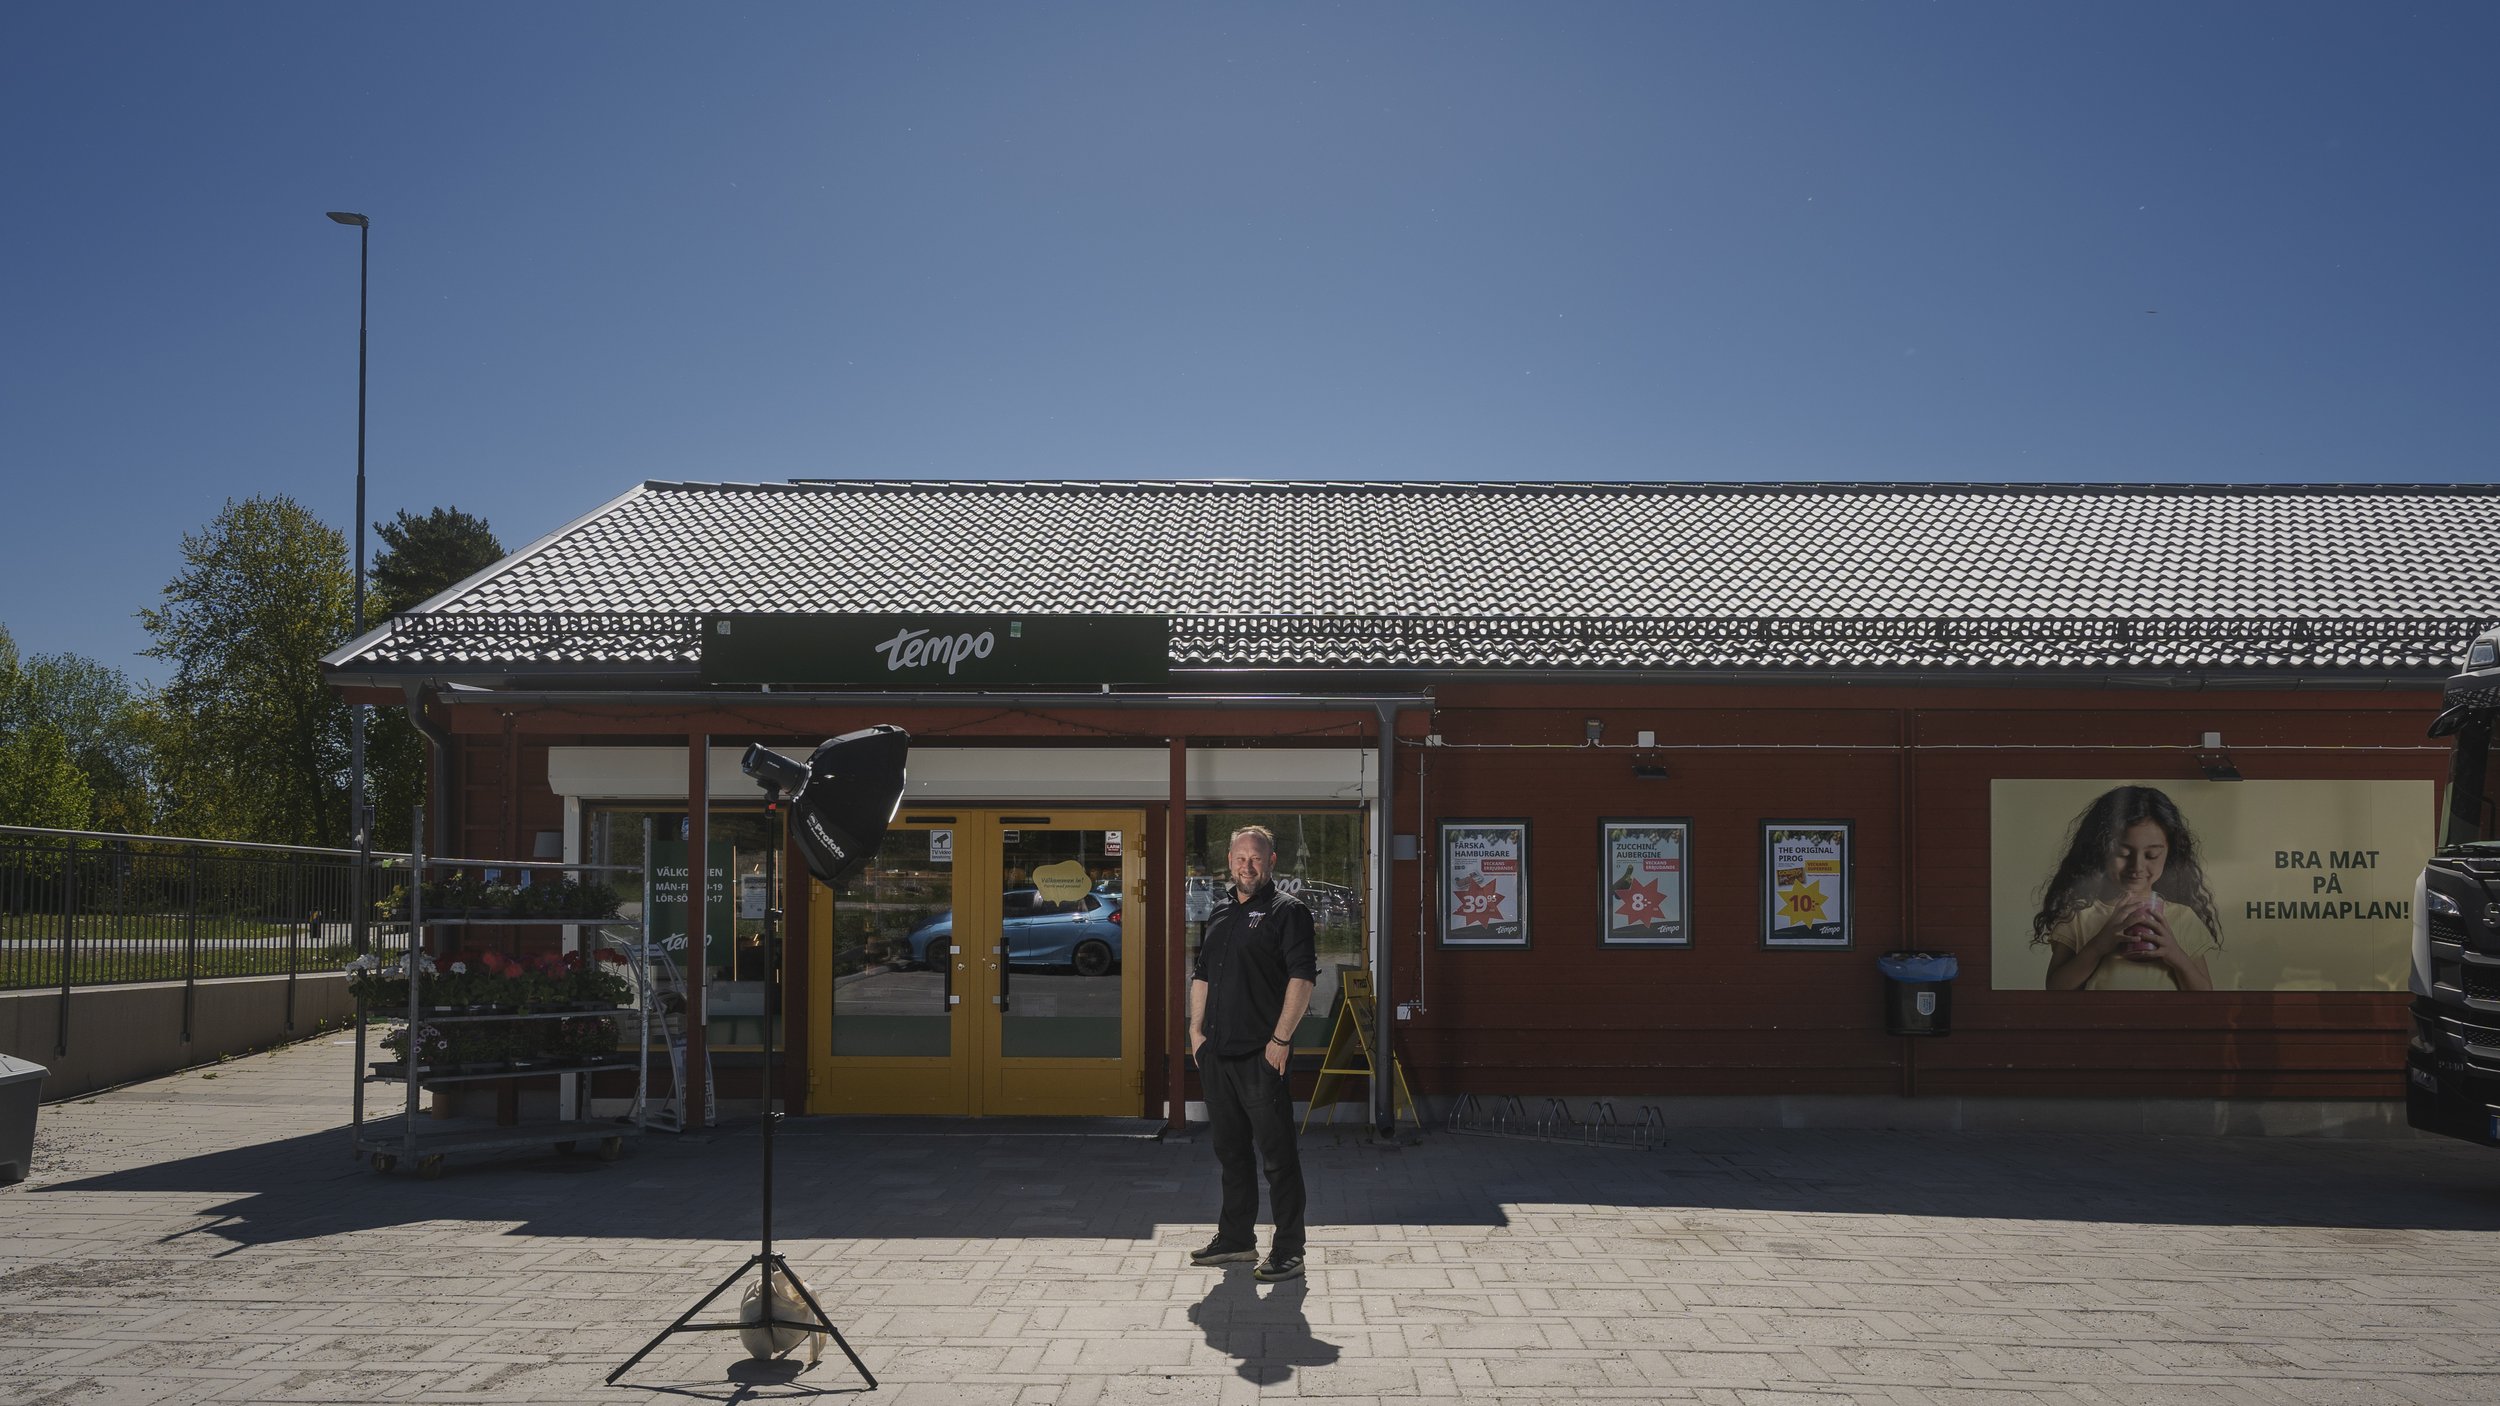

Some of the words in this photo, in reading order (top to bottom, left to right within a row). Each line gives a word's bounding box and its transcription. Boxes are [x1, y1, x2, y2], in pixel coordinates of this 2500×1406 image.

[874, 628, 994, 675] tempo
[814, 823, 845, 858] Profoto
[1455, 841, 1485, 849] FÄRSKA
[2275, 851, 2322, 868] BRA
[2330, 851, 2379, 868] MAT
[656, 866, 723, 877] VÄLKOEN
[655, 882, 688, 891] MÅN-F
[2313, 872, 2342, 894] PÅ
[655, 893, 688, 902] LÖR-SÖ
[2246, 901, 2409, 919] HEMMAPLAN!
[1496, 925, 1517, 935] tempo
[1657, 925, 1680, 934] tempo
[1819, 925, 1840, 935] tempo
